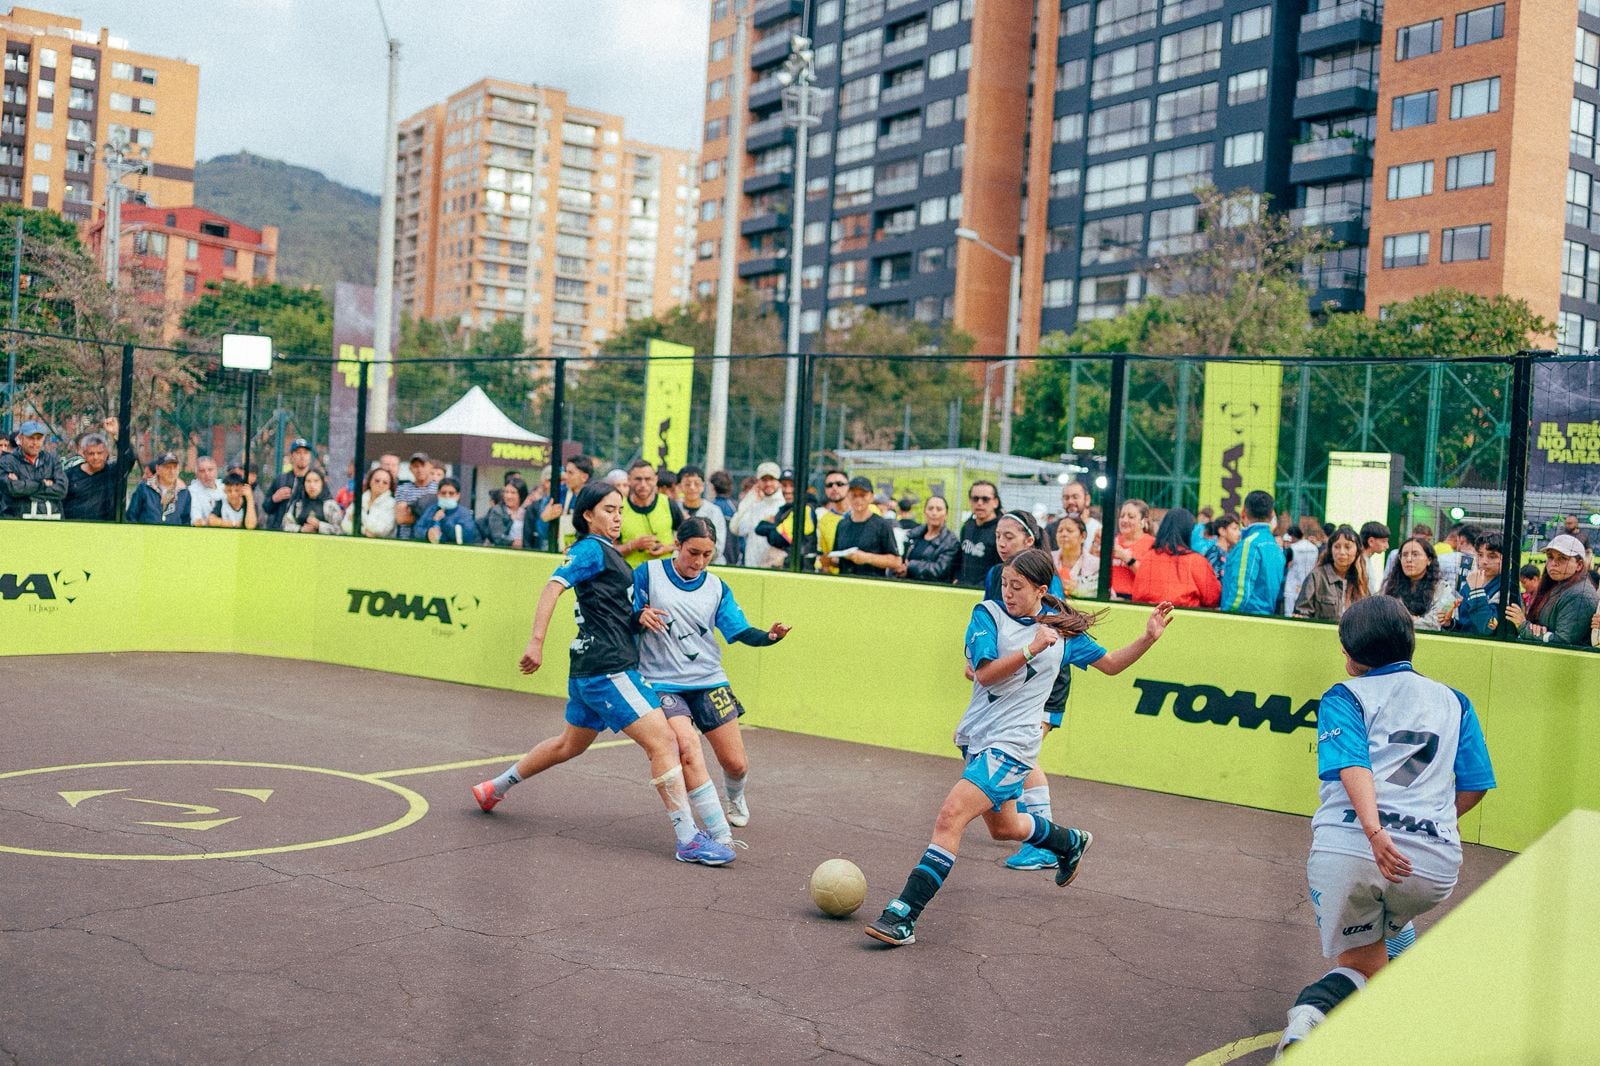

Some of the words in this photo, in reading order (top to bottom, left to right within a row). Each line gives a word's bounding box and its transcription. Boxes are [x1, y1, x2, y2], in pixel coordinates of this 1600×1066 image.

[1540, 422, 1562, 437] EL
[1537, 436, 1566, 450] NO
[1571, 437, 1600, 450] NO
[1548, 449, 1600, 464] PARA
[348, 589, 452, 624] TOMA
[709, 687, 731, 709] 53
[1385, 730, 1440, 787] 7
